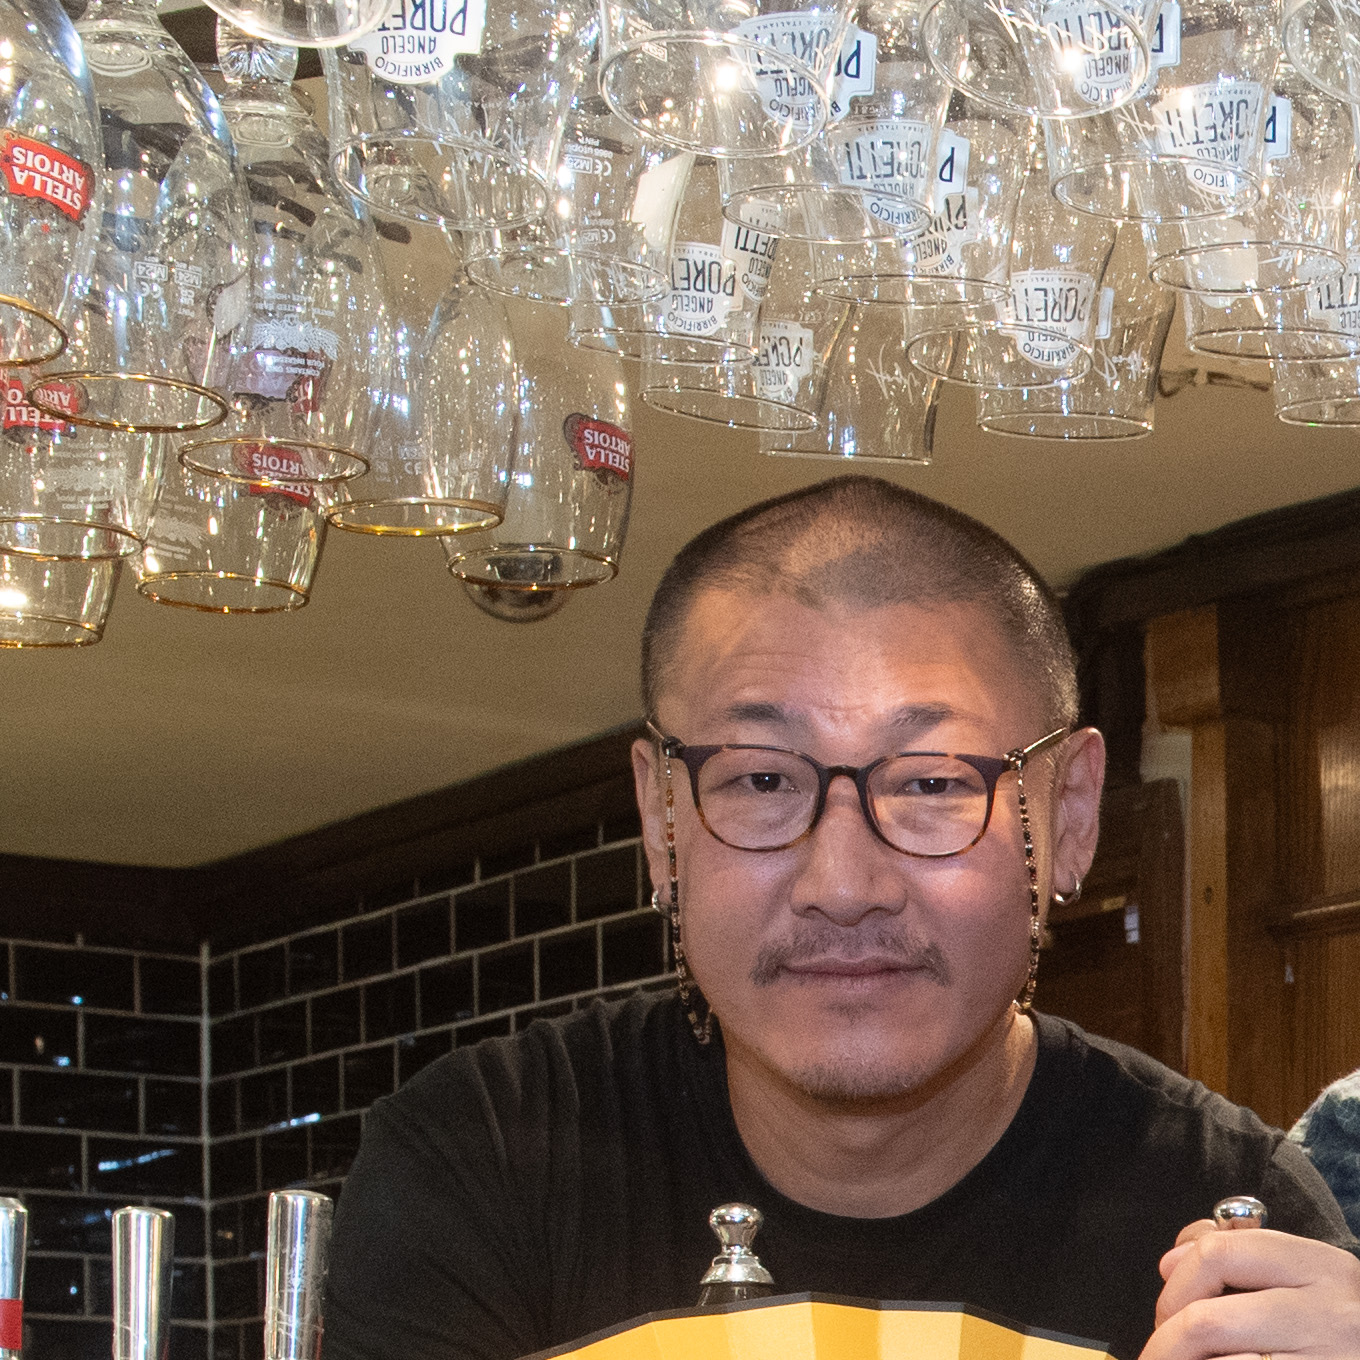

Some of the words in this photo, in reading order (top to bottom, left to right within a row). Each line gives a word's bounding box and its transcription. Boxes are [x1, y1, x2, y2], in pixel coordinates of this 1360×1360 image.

[381, 35, 437, 54] ANGELO
[375, 56, 443, 77] BIRRIFICIO
[12, 146, 85, 191] ARTOIS
[11, 166, 82, 210] STELLA
[668, 312, 716, 332] BIRRIFICIO
[584, 429, 630, 456] ARTOIS
[585, 445, 630, 472] STELLA
